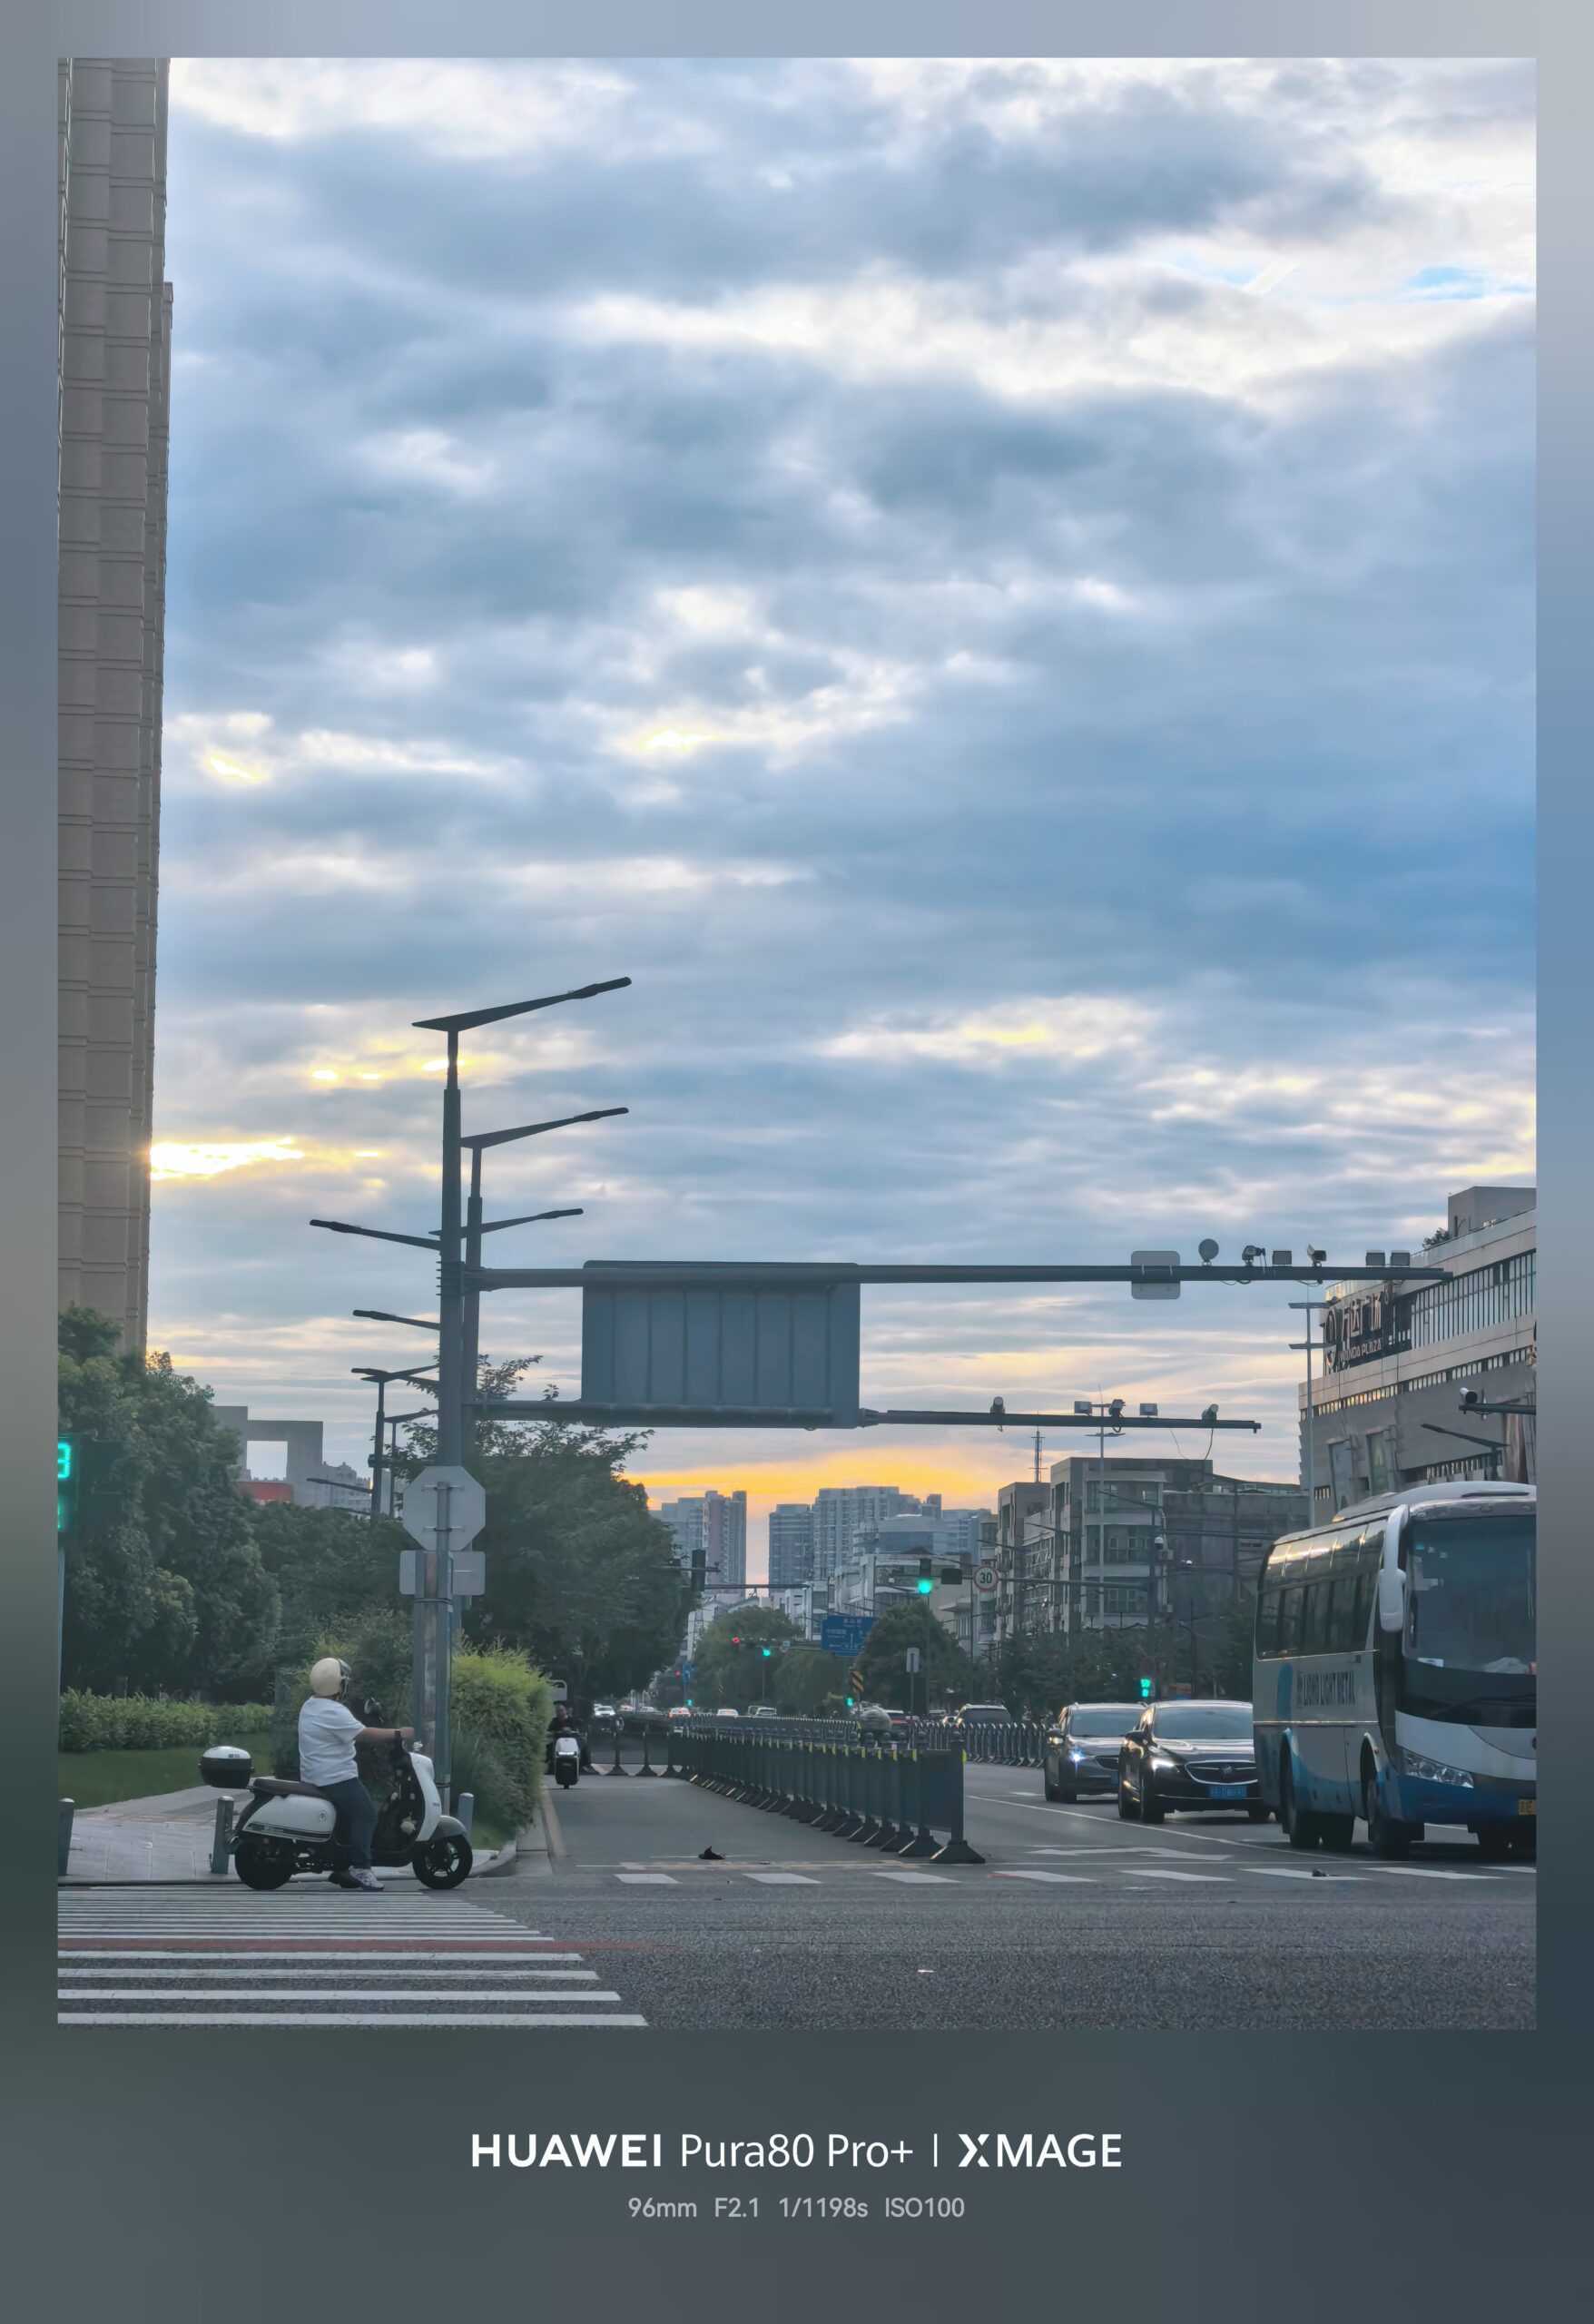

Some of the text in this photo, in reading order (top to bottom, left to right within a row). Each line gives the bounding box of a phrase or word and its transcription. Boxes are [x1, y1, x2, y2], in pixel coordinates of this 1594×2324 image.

[1342, 1293, 1382, 1351] 万达广场
[1362, 1338, 1382, 1356] PLAZA
[979, 1571, 992, 1584] 30
